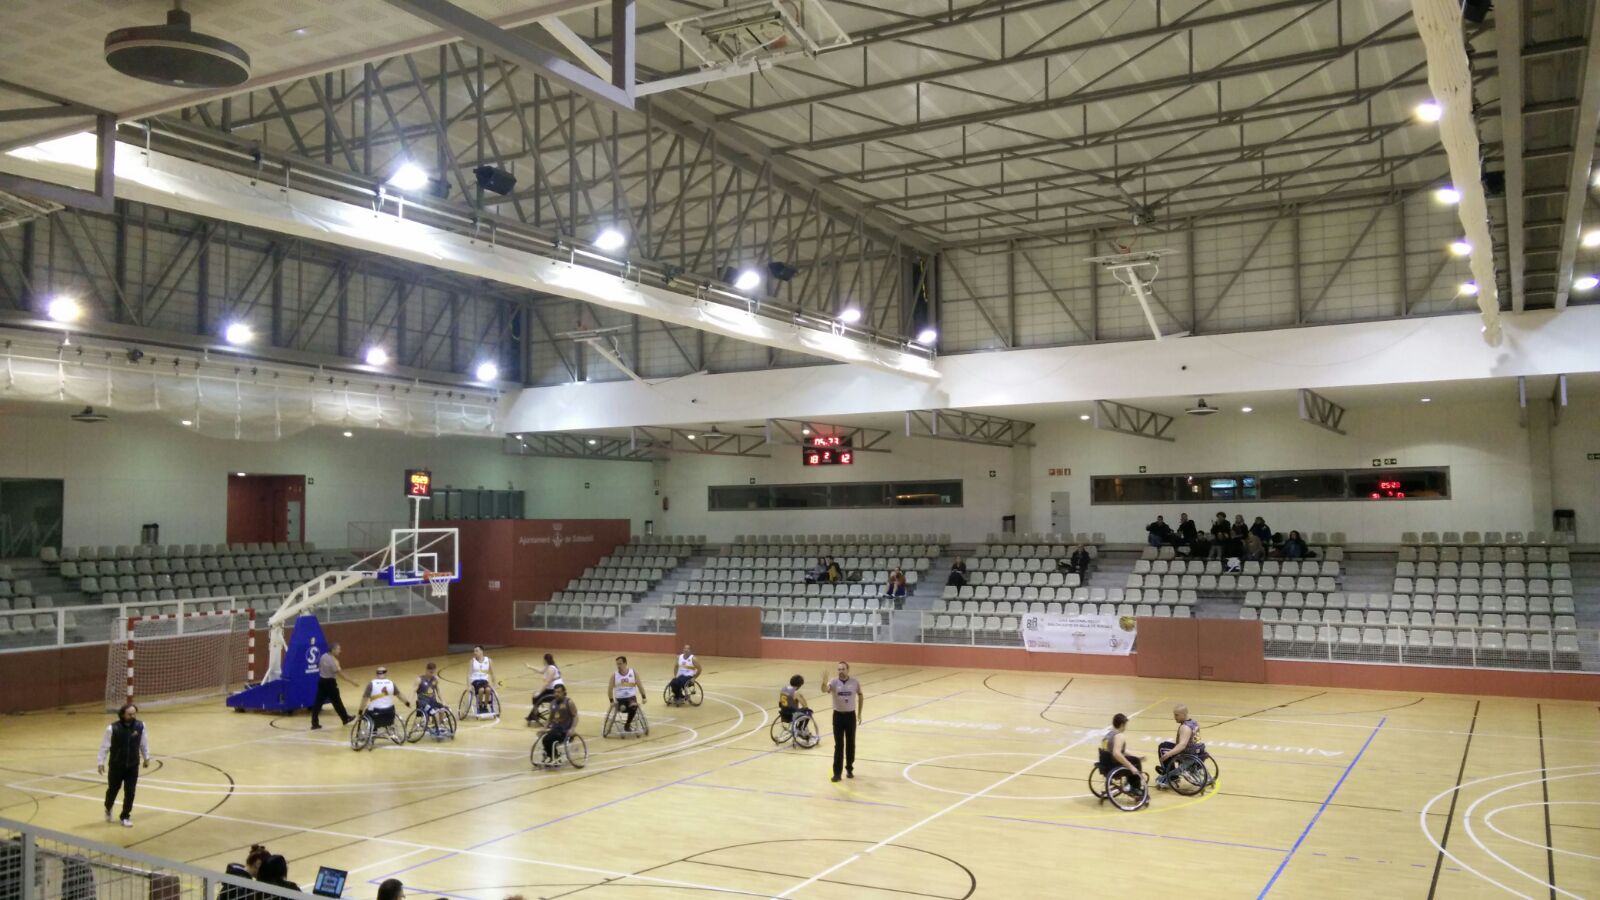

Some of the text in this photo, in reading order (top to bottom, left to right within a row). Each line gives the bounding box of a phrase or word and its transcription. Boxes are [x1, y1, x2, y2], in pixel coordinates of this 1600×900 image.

[810, 455, 819, 464] 18
[841, 454, 850, 463] 12
[412, 483, 426, 494] 24
